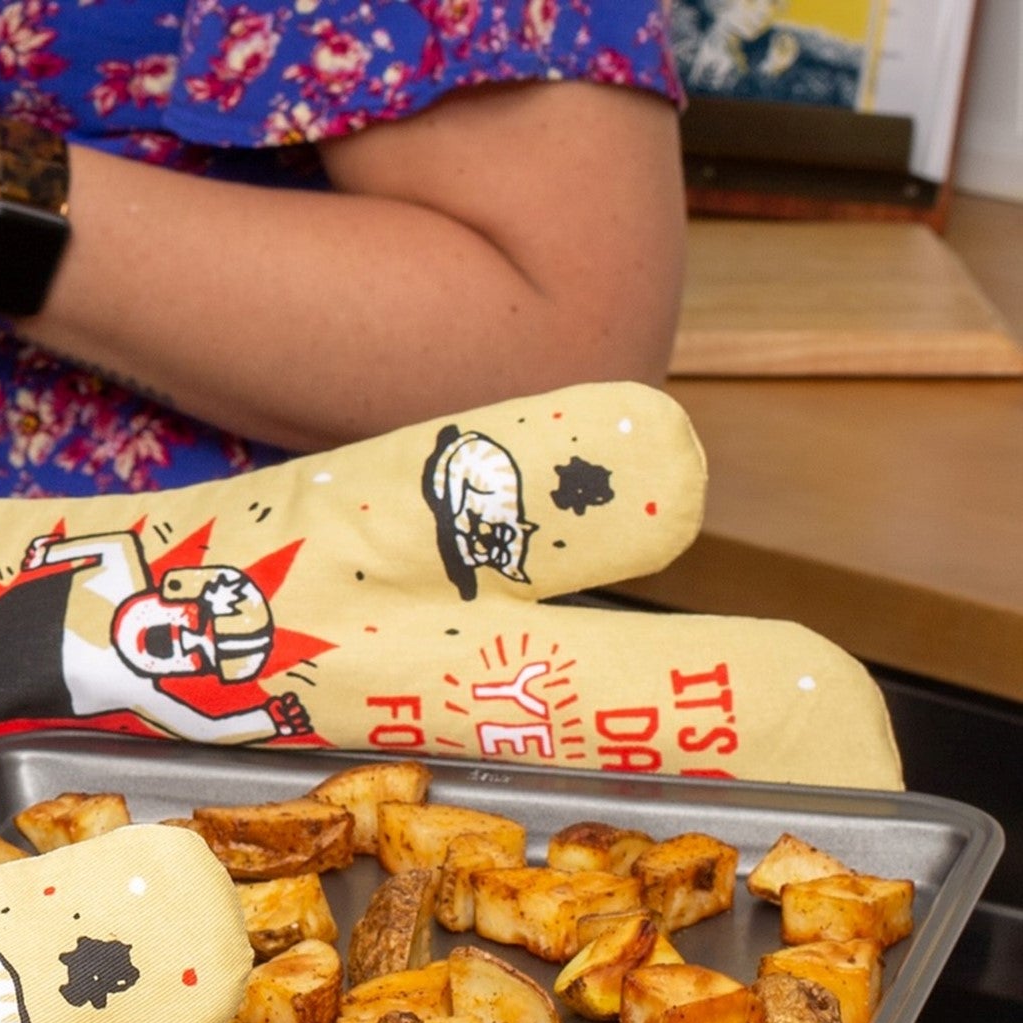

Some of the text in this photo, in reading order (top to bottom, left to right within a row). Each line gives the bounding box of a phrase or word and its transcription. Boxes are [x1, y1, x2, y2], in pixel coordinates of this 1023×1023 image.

[366, 696, 427, 755] FO
[472, 661, 555, 761] YE
[670, 663, 739, 755] IT'S
